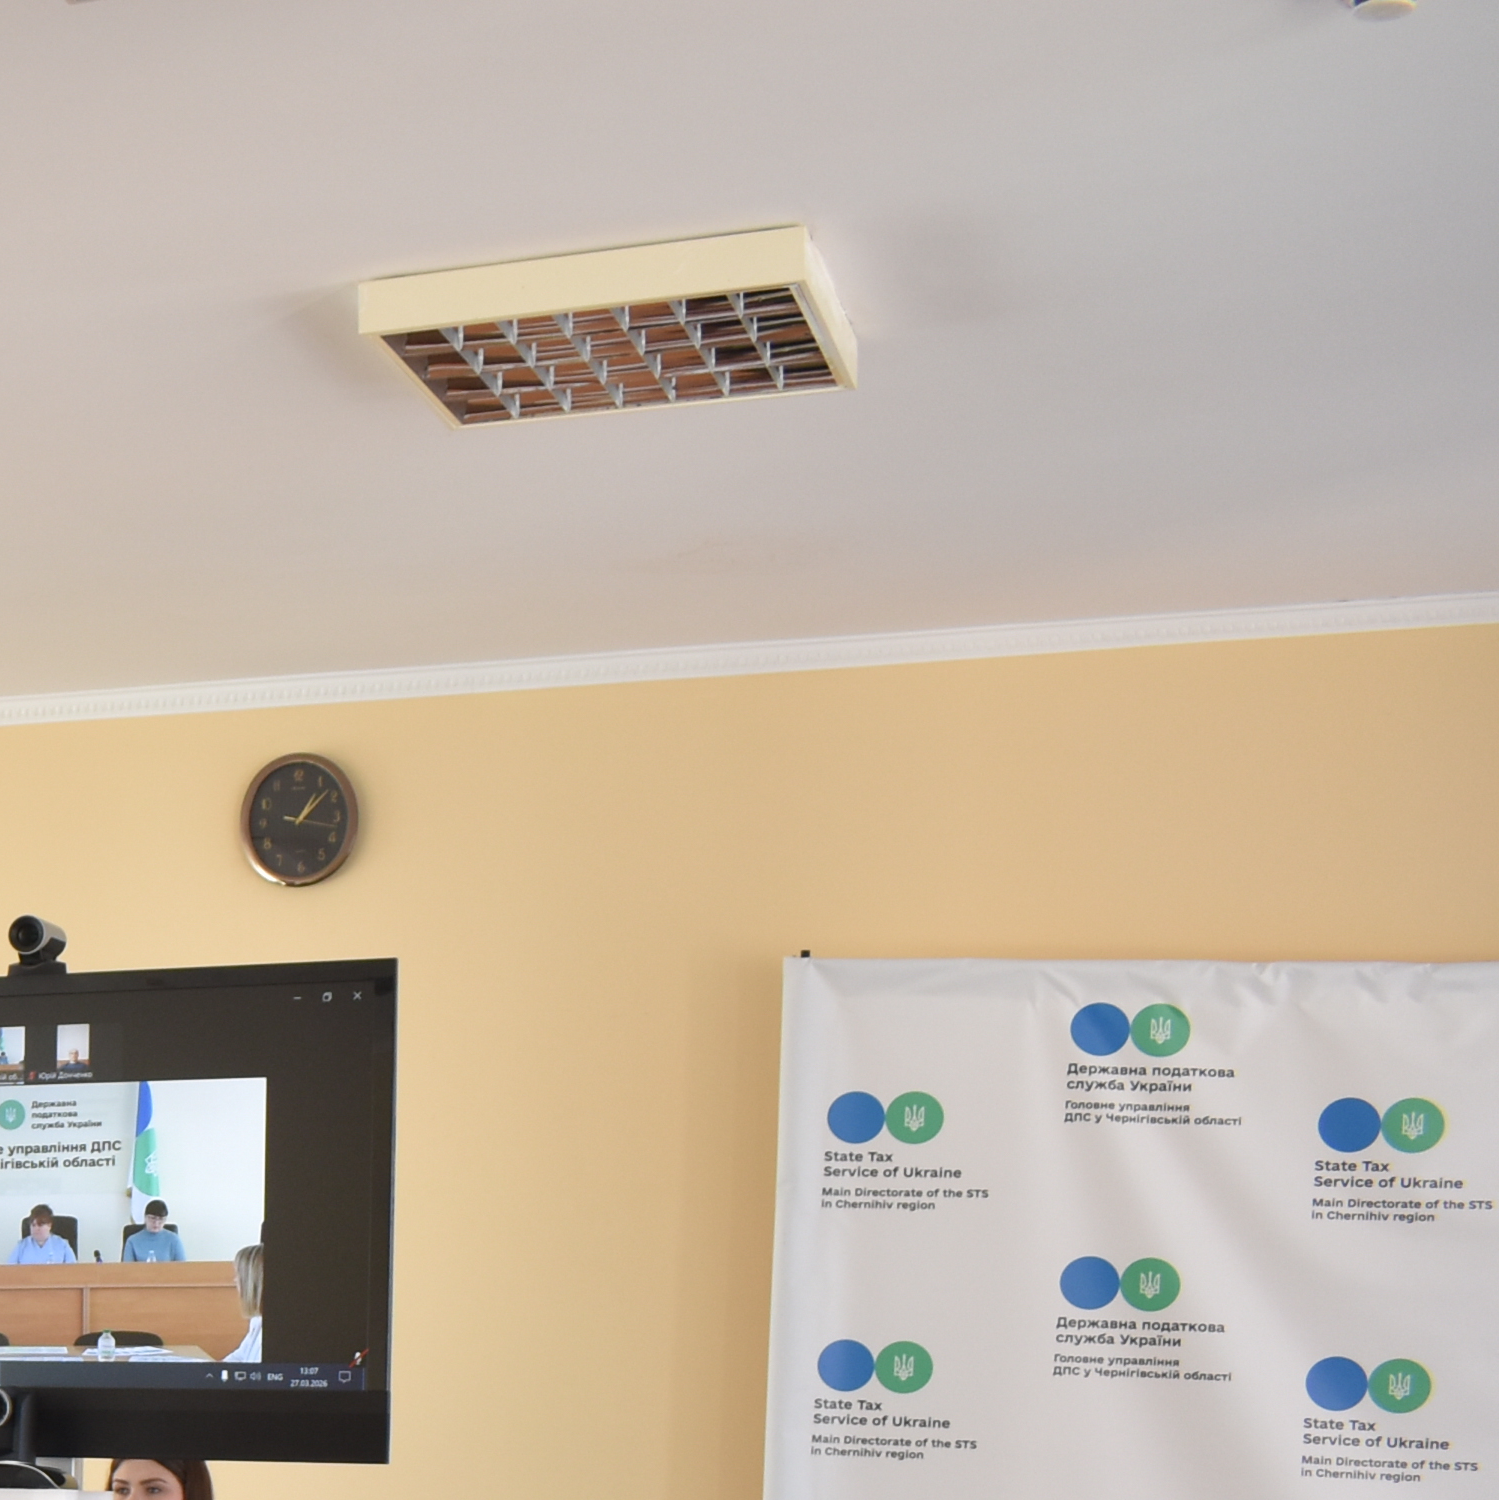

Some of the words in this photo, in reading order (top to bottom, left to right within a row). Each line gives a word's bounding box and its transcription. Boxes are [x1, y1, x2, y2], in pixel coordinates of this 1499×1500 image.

[330, 790, 339, 803] 2
[333, 811, 341, 823] 3
[263, 838, 272, 849] 8
[328, 831, 337, 843] 4
[275, 854, 283, 867] 7
[318, 848, 326, 861] 5
[297, 861, 306, 873] 6
[1066, 1062, 1148, 1077] Державна
[1151, 1066, 1236, 1079] податкова
[1066, 1079, 1125, 1093] служба
[1129, 1080, 1193, 1095] України
[31, 1100, 77, 1109] Державна
[1064, 1099, 1116, 1110] Головне
[1118, 1102, 1191, 1113] управління
[31, 1110, 78, 1119] податкова
[1063, 1112, 1092, 1124] ДПС
[1094, 1114, 1103, 1125] у
[1105, 1113, 1191, 1125] Чернігівській
[1193, 1115, 1242, 1126] області
[31, 1121, 65, 1130] служба
[67, 1119, 102, 1129] України
[7, 1142, 87, 1157] управління
[90, 1140, 122, 1154] ДПС
[62, 1155, 116, 1168] області
[823, 1150, 864, 1163] State
[867, 1151, 894, 1163] Tax
[823, 1165, 879, 1178] Service
[882, 1165, 900, 1178] of
[903, 1166, 963, 1179] Ukraine
[1314, 1159, 1358, 1172] State
[1361, 1160, 1390, 1173] Tax
[1313, 1175, 1374, 1189] Service
[1377, 1176, 1397, 1189] of
[1400, 1176, 1464, 1190] Ukraine
[821, 1186, 852, 1197] Main
[854, 1187, 924, 1198] Directorate
[926, 1188, 941, 1198] of
[942, 1188, 964, 1199] the
[966, 1188, 990, 1199] STS
[820, 1198, 833, 1209] in
[835, 1199, 894, 1210] Chernihiv
[896, 1200, 936, 1212] region
[1311, 1197, 1344, 1208] Main
[1347, 1198, 1422, 1210] Directorate
[1424, 1199, 1440, 1210] of
[1442, 1199, 1466, 1210] the
[1468, 1200, 1494, 1210] STS
[1311, 1209, 1324, 1220] in
[1326, 1210, 1390, 1222] Chernihiv
[1392, 1211, 1436, 1224] region
[1055, 1316, 1138, 1331] Державна
[1141, 1321, 1226, 1334] податкова
[1055, 1332, 1115, 1347] служба
[1119, 1333, 1182, 1349] України
[1053, 1353, 1105, 1365] Головне
[1107, 1356, 1180, 1367] управління
[267, 1372, 284, 1381] ENG
[299, 1366, 319, 1375] 13:07
[1052, 1365, 1081, 1377] ДПС
[1083, 1368, 1092, 1379] у
[1094, 1367, 1181, 1380] Чернігівській
[1183, 1370, 1232, 1382] області
[813, 1397, 853, 1411] State
[856, 1399, 883, 1412] Tax
[812, 1412, 868, 1426] Service
[871, 1414, 889, 1427] of
[891, 1415, 951, 1430] Ukraine
[1303, 1417, 1345, 1431] State
[1348, 1419, 1376, 1432] Tax
[811, 1434, 841, 1444] Main
[843, 1435, 913, 1448] Directorate
[914, 1437, 929, 1448] of
[930, 1438, 952, 1449] the
[954, 1439, 978, 1450] STS
[1302, 1432, 1361, 1447] Service
[1364, 1435, 1383, 1448] of
[1386, 1436, 1450, 1451] Ukraine
[810, 1445, 822, 1456] in
[824, 1446, 883, 1458] Chernihiv
[885, 1449, 925, 1461] region
[1301, 1455, 1332, 1466] Main
[1335, 1456, 1409, 1470] Directorate
[1411, 1459, 1426, 1470] of
[1428, 1460, 1451, 1471] the
[1453, 1461, 1479, 1472] STS
[1300, 1467, 1313, 1477] in
[1315, 1468, 1377, 1481] Chernihiv
[1379, 1471, 1421, 1484] region
